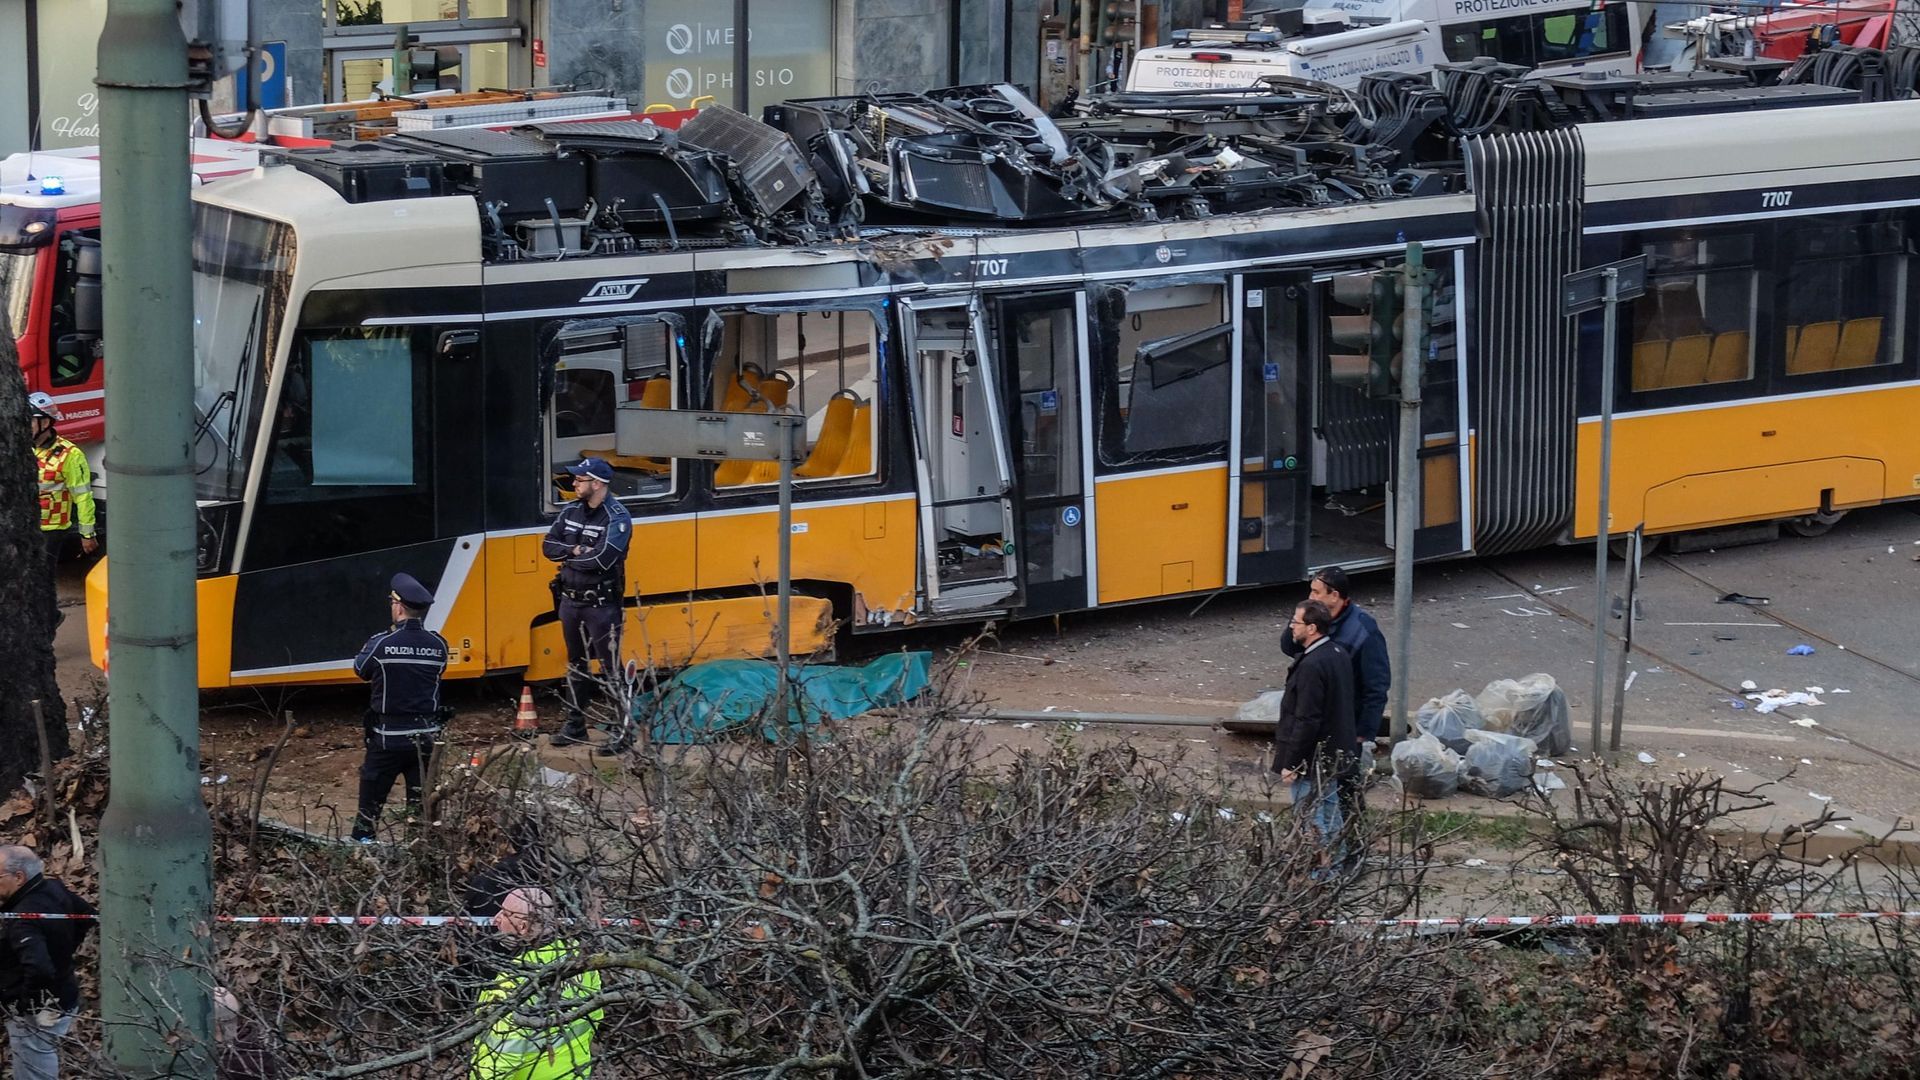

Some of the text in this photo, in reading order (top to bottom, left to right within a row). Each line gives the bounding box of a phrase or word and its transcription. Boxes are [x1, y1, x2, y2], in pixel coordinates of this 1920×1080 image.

[706, 28, 752, 45] ME
[1156, 67, 1226, 79] PROTEZIONE
[1311, 64, 1336, 81] POSTO
[706, 69, 793, 89] PHSIO
[1173, 81, 1205, 89] COMUNE
[1761, 191, 1793, 208] 7707
[970, 259, 1009, 276] 7707
[600, 285, 628, 297] ATM
[65, 409, 100, 419] MAGIRUS
[463, 639, 470, 648] B
[384, 646, 414, 655] POLIZIA
[416, 648, 442, 657] LOCALE
